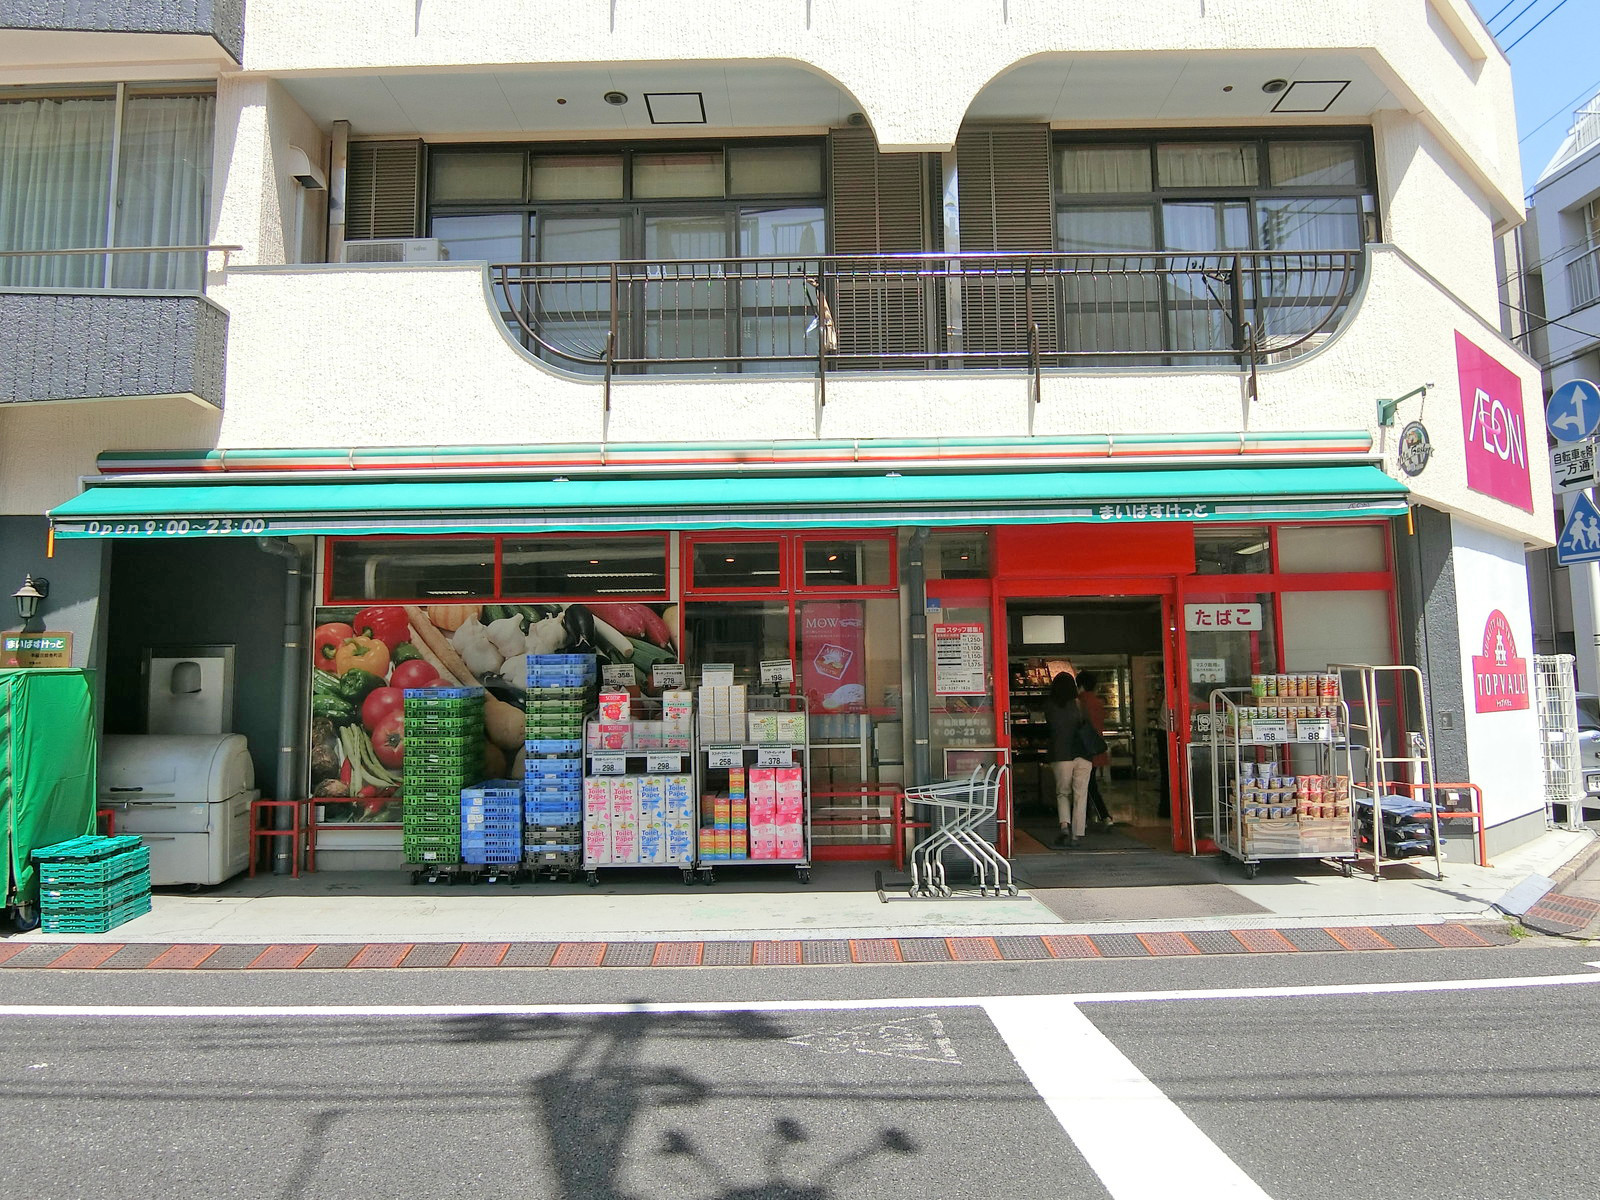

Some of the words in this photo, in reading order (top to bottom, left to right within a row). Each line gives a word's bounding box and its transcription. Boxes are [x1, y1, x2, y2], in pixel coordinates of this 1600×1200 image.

[1555, 460, 1593, 475] 一方通
[1099, 504, 1208, 520] まいばすけっと
[88, 521, 139, 536] Open
[806, 618, 838, 628] MOW
[1196, 610, 1252, 625] たばこ
[6, 640, 64, 648] まいばすけっと
[1478, 674, 1526, 696] TOPVALU
[1264, 732, 1276, 740] 158
[1308, 732, 1320, 740] 88
